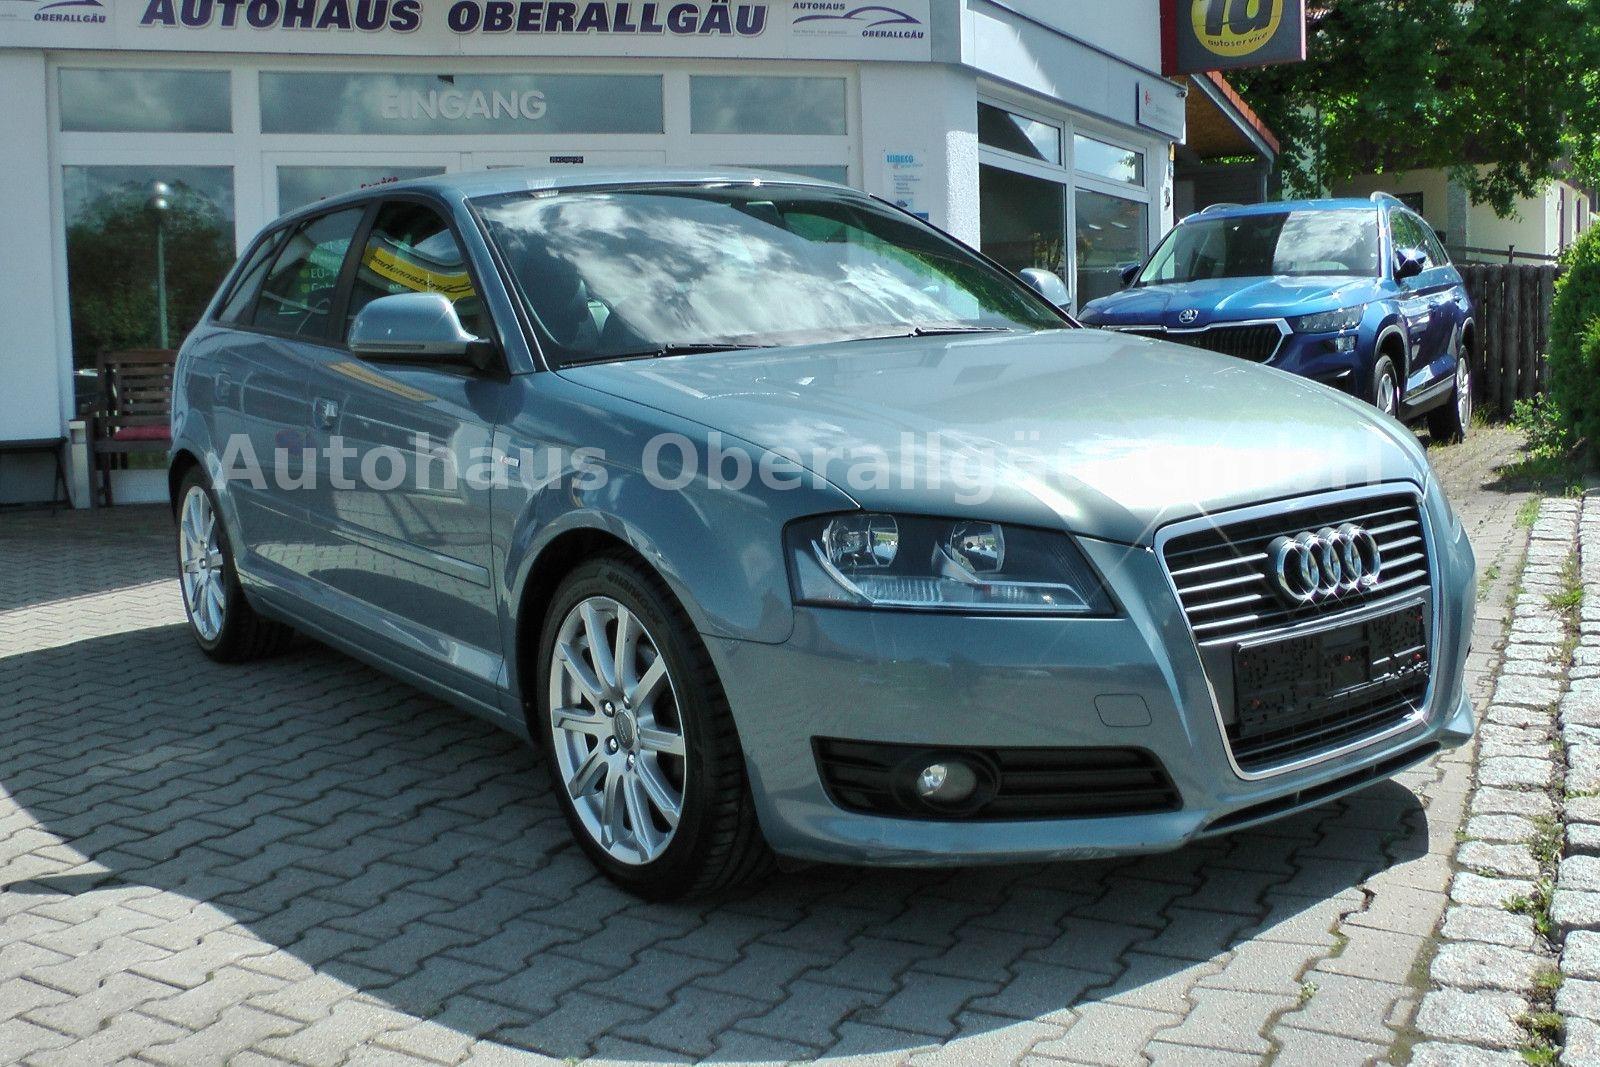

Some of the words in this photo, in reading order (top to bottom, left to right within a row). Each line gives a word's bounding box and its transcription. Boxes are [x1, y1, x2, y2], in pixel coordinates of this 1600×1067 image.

[792, 2, 846, 11] AUTOHAUS
[33, 13, 107, 24] OBERALLGÄU
[139, 0, 421, 32] AUTOHAUS
[448, 0, 768, 36] OBERALLGÄU
[861, 29, 924, 39] OBERALLGÄU
[1207, 31, 1268, 47] autoservice
[381, 89, 547, 120] EINGANG
